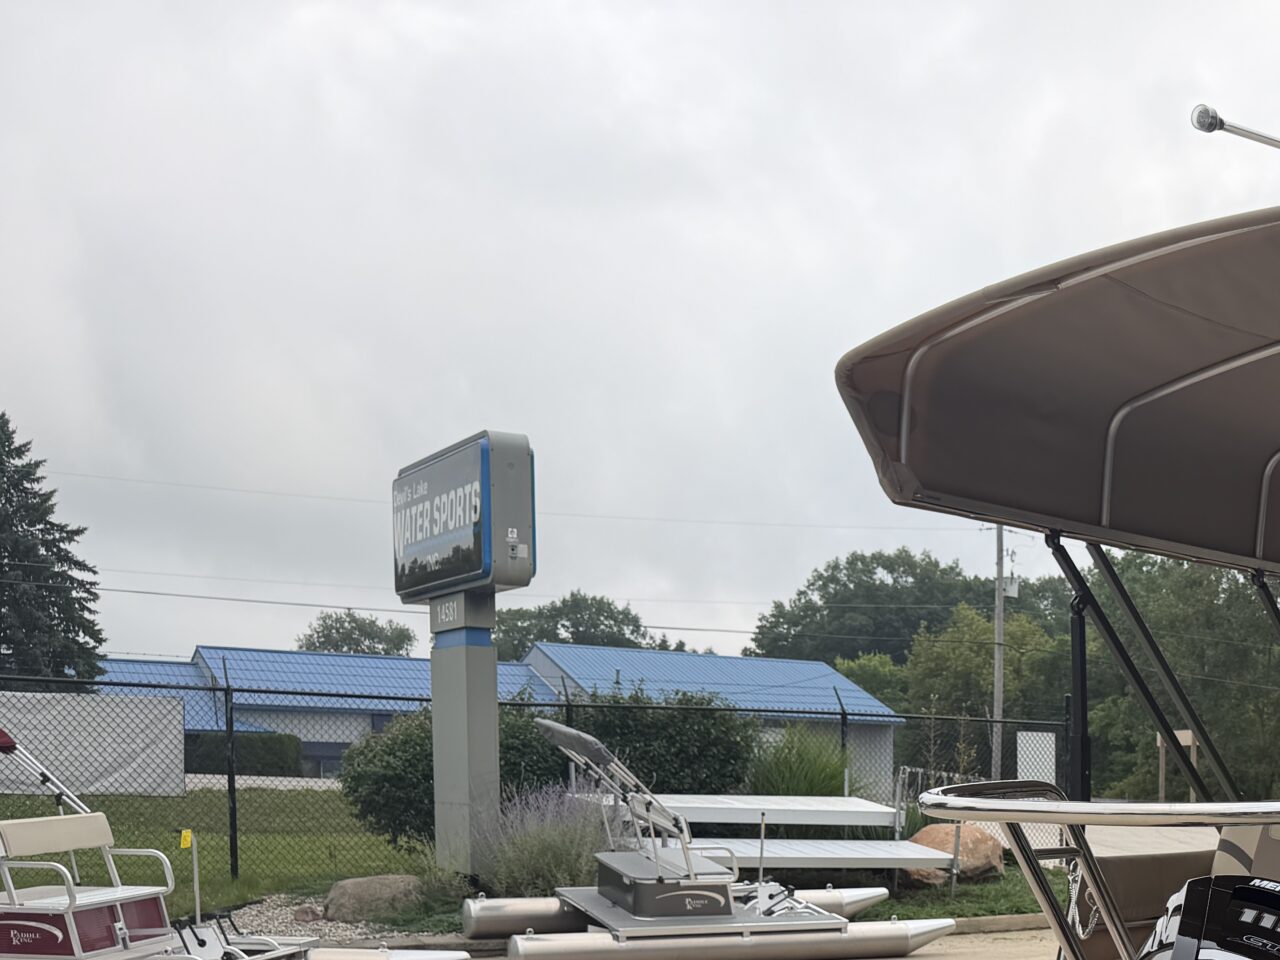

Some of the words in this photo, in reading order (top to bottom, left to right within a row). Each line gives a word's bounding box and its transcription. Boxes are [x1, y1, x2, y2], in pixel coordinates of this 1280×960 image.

[413, 480, 428, 499] Lake
[394, 500, 430, 558] WATER
[433, 480, 480, 536] SPORTS
[437, 601, 457, 624] 14581
